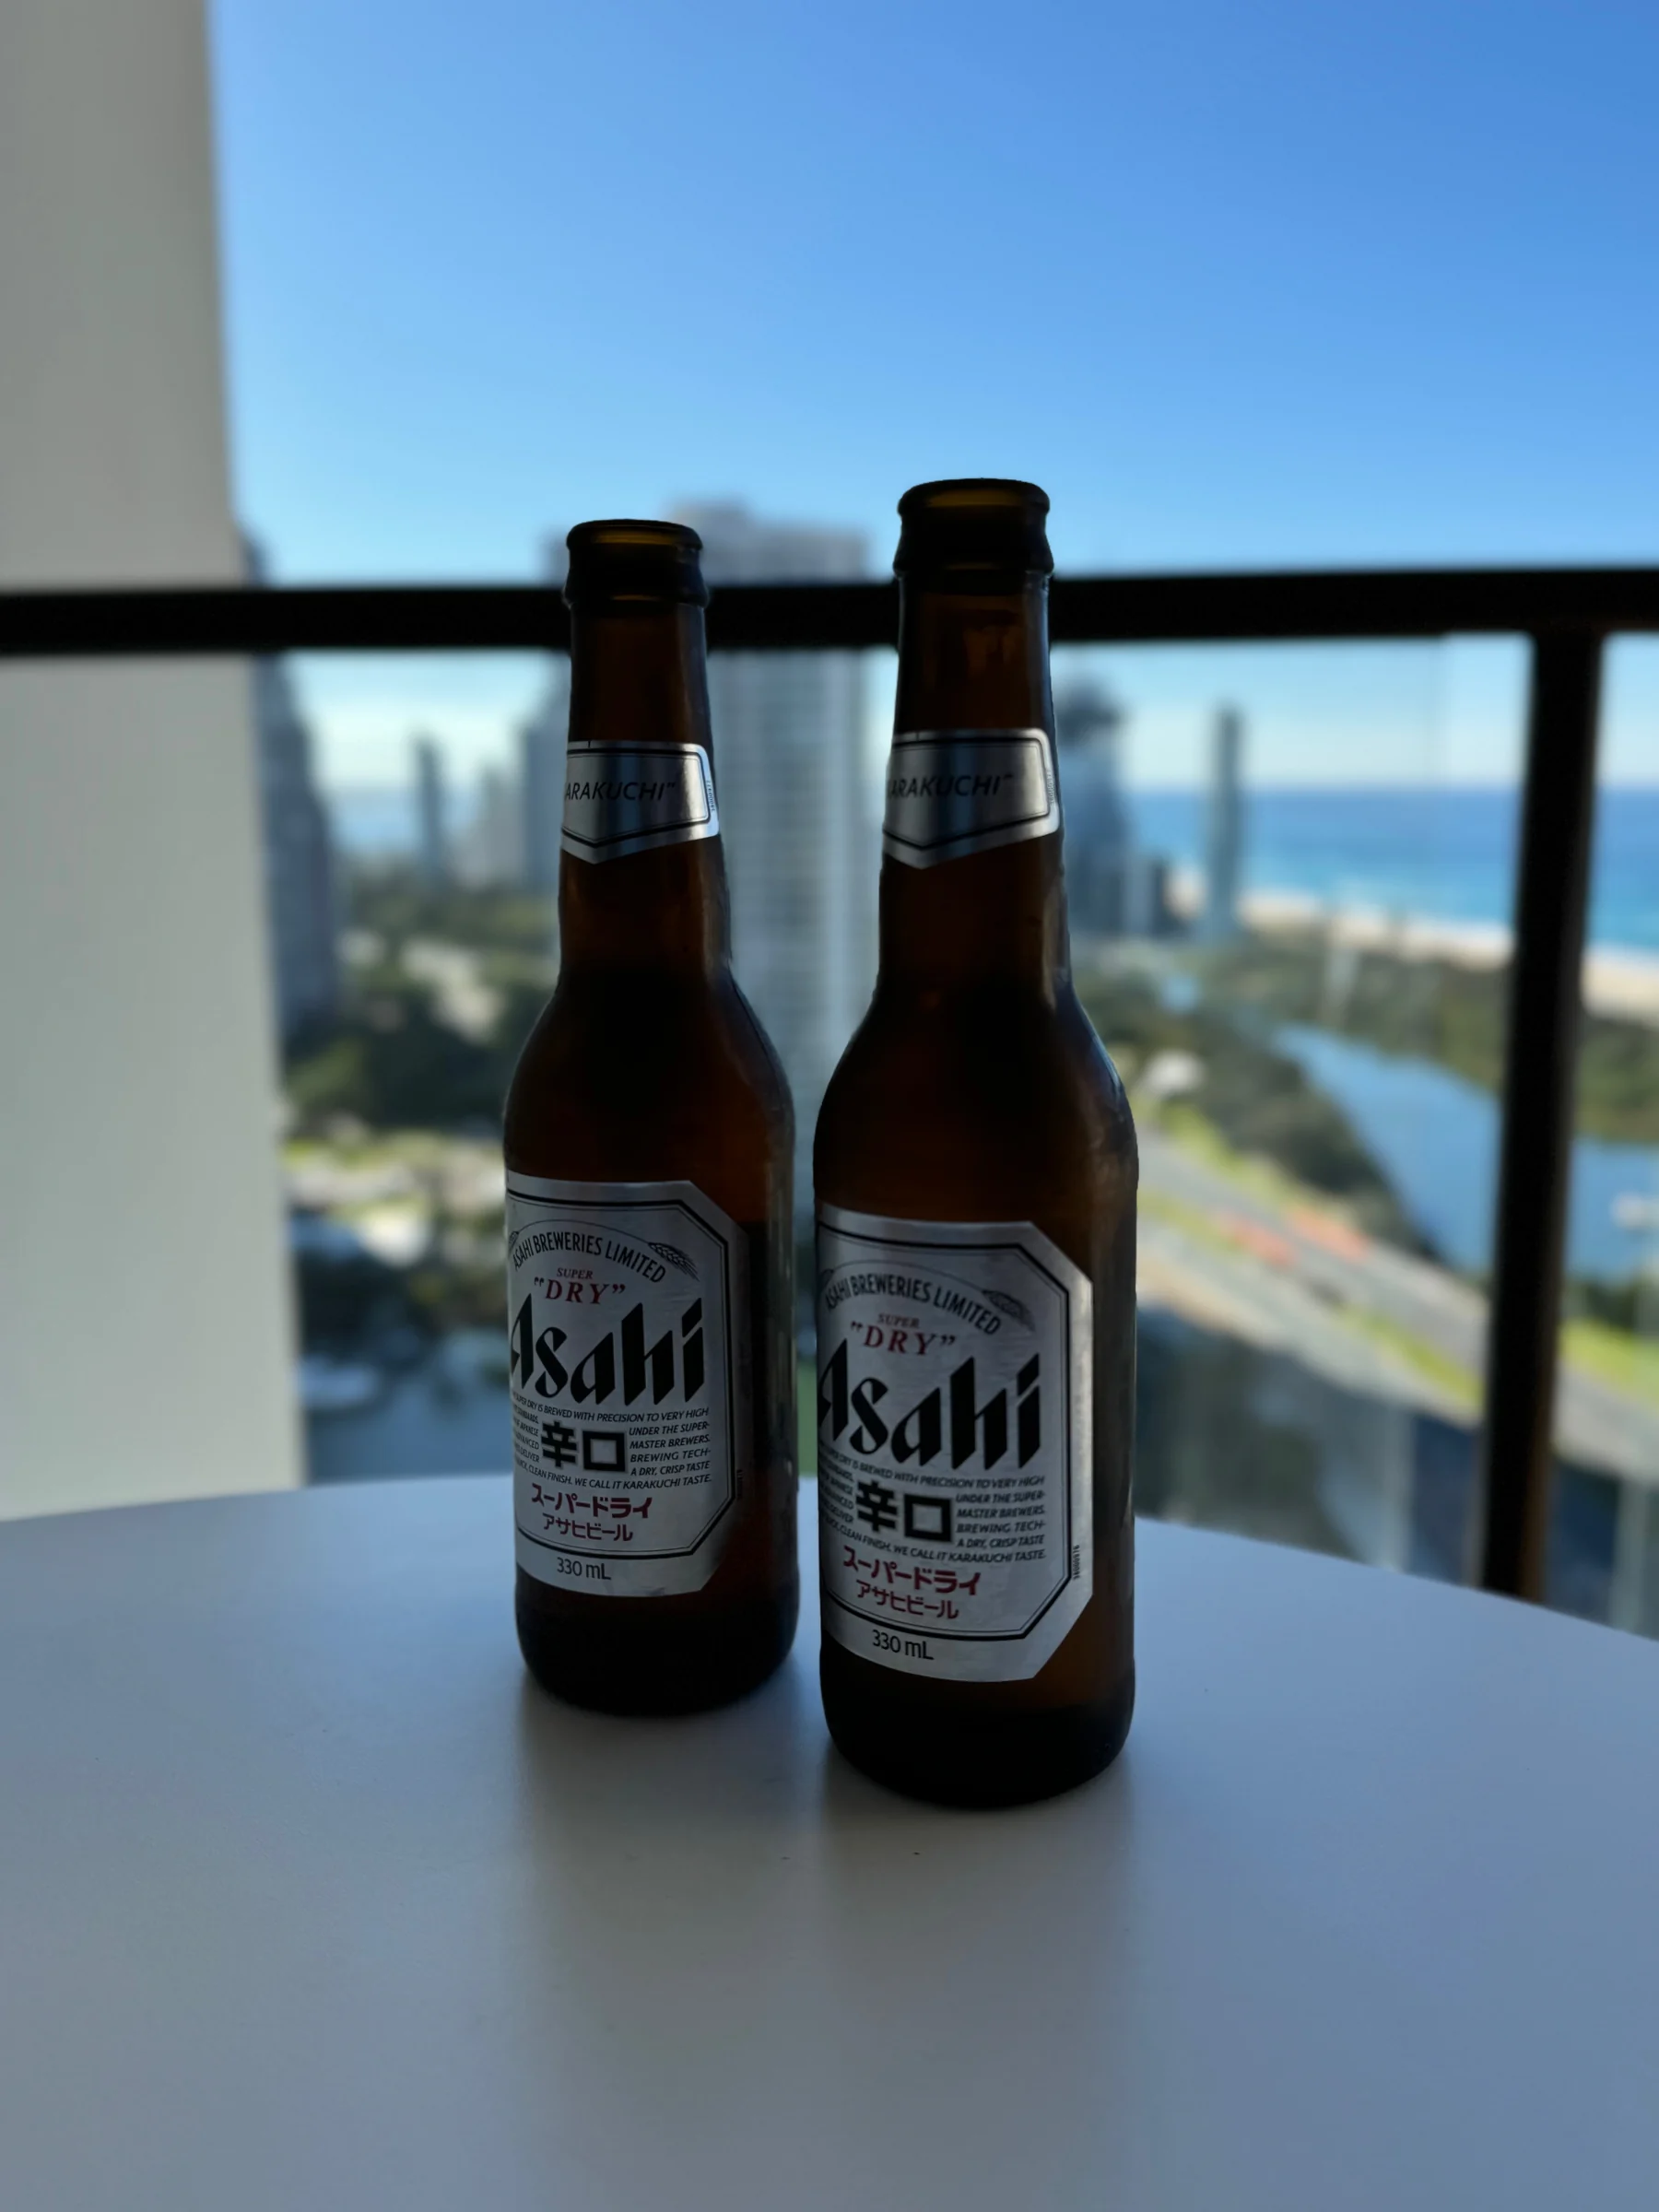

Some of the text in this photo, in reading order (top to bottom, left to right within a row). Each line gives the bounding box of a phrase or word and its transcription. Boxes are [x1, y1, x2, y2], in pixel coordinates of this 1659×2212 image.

[512, 1231, 666, 1283] ASAHI BREWERIES LIMITED
[556, 1267, 594, 1280] SUPER
[850, 1273, 933, 1303] BREWERIES
[933, 1286, 1002, 1335] LIMITED
[877, 1312, 920, 1329] SUPER
[511, 1292, 705, 1406] Asahi
[527, 1399, 537, 1410] DRY
[538, 1404, 544, 1412] IS
[544, 1406, 572, 1418] BREWED
[573, 1411, 595, 1421] WITH
[596, 1412, 645, 1423] PRECISION
[647, 1413, 660, 1422] TO
[661, 1410, 685, 1421] VERY
[686, 1407, 710, 1418] HIGH
[818, 1338, 1041, 1471] Asahi
[629, 1420, 711, 1436] UNDER THE SUPER-
[540, 1420, 626, 1473] 辛口
[629, 1434, 711, 1450] MASTER BREWERS.
[629, 1448, 711, 1463] BREWING TECH-
[528, 1465, 547, 1478] CLEAN
[547, 1471, 572, 1485] FINISH.
[575, 1477, 587, 1488] WE
[589, 1479, 610, 1489] CALL
[612, 1480, 622, 1489] IT
[623, 1477, 680, 1489] KARAKUCHI
[683, 1474, 712, 1486] TASTE.
[630, 1460, 711, 1477] A DRY, CRISP TASTE
[859, 1462, 893, 1478] BREWED
[895, 1471, 919, 1483] WITH
[920, 1476, 973, 1488] PRECISION
[976, 1477, 990, 1488] TO
[992, 1477, 1017, 1488] VERY
[1018, 1475, 1045, 1487] HIGH
[531, 1482, 653, 1519] スーパードライ
[956, 1489, 1045, 1503] UNDER THE SUPER-
[855, 1479, 952, 1543] 辛口
[957, 1508, 998, 1518] MASTER
[542, 1512, 633, 1542] アサヒビール
[956, 1520, 1046, 1534] BREWING TECH-
[957, 1538, 964, 1547] A
[989, 1538, 1018, 1548] CRISP
[1018, 1534, 1045, 1547] TASTE
[894, 1545, 908, 1556] WE
[911, 1548, 935, 1560] CALL
[936, 1551, 947, 1560] IT
[948, 1549, 1012, 1563] KARAKUCHI
[557, 1557, 611, 1581] 330 mL
[843, 1545, 982, 1595] スーパードライ
[856, 1579, 959, 1619] アサヒビール
[872, 1629, 935, 1661] 330 mL
